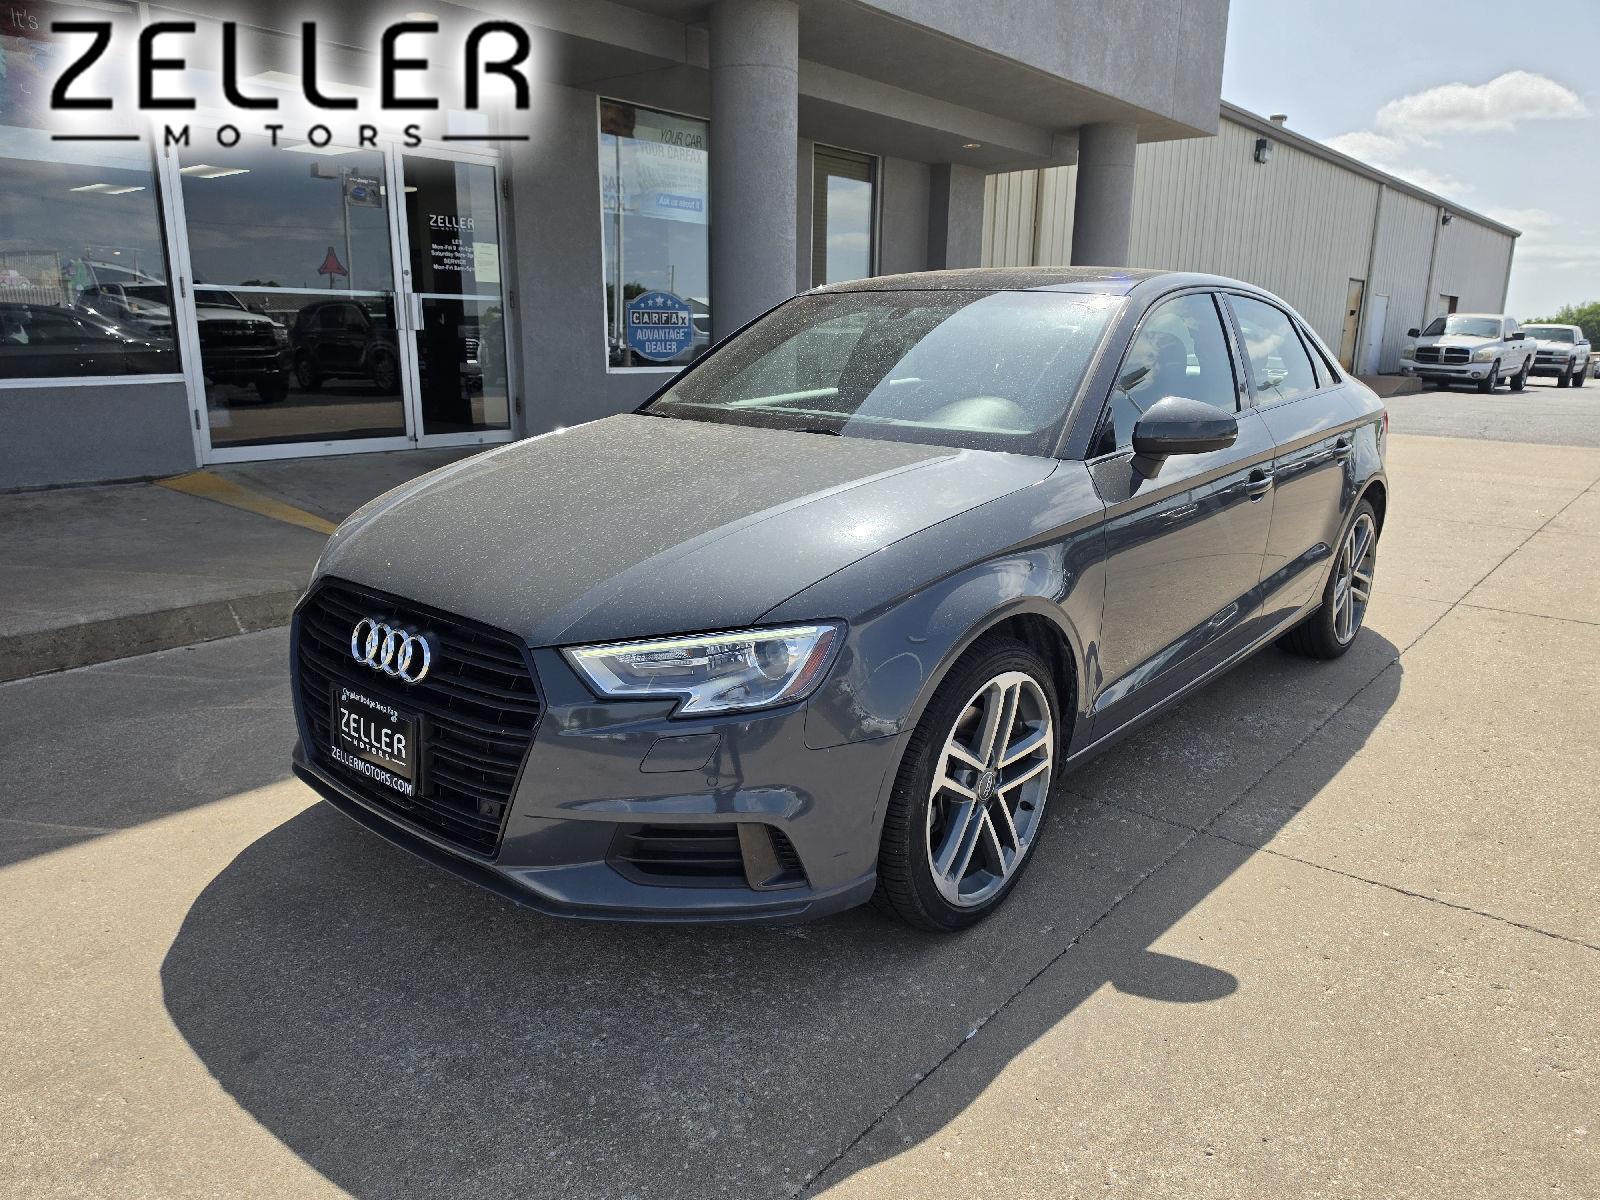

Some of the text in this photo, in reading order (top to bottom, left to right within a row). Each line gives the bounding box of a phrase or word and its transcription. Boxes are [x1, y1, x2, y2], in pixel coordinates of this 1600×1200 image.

[10, 8, 39, 30] It's
[660, 128, 703, 150] YOUR CAR
[429, 214, 474, 229] ZELLER
[633, 312, 687, 326] CARFAX
[645, 341, 677, 353] DEALER
[340, 707, 406, 759] ZELLER
[353, 738, 391, 761] MOTORS
[331, 745, 413, 797] ZELLERMOTORS.COM
